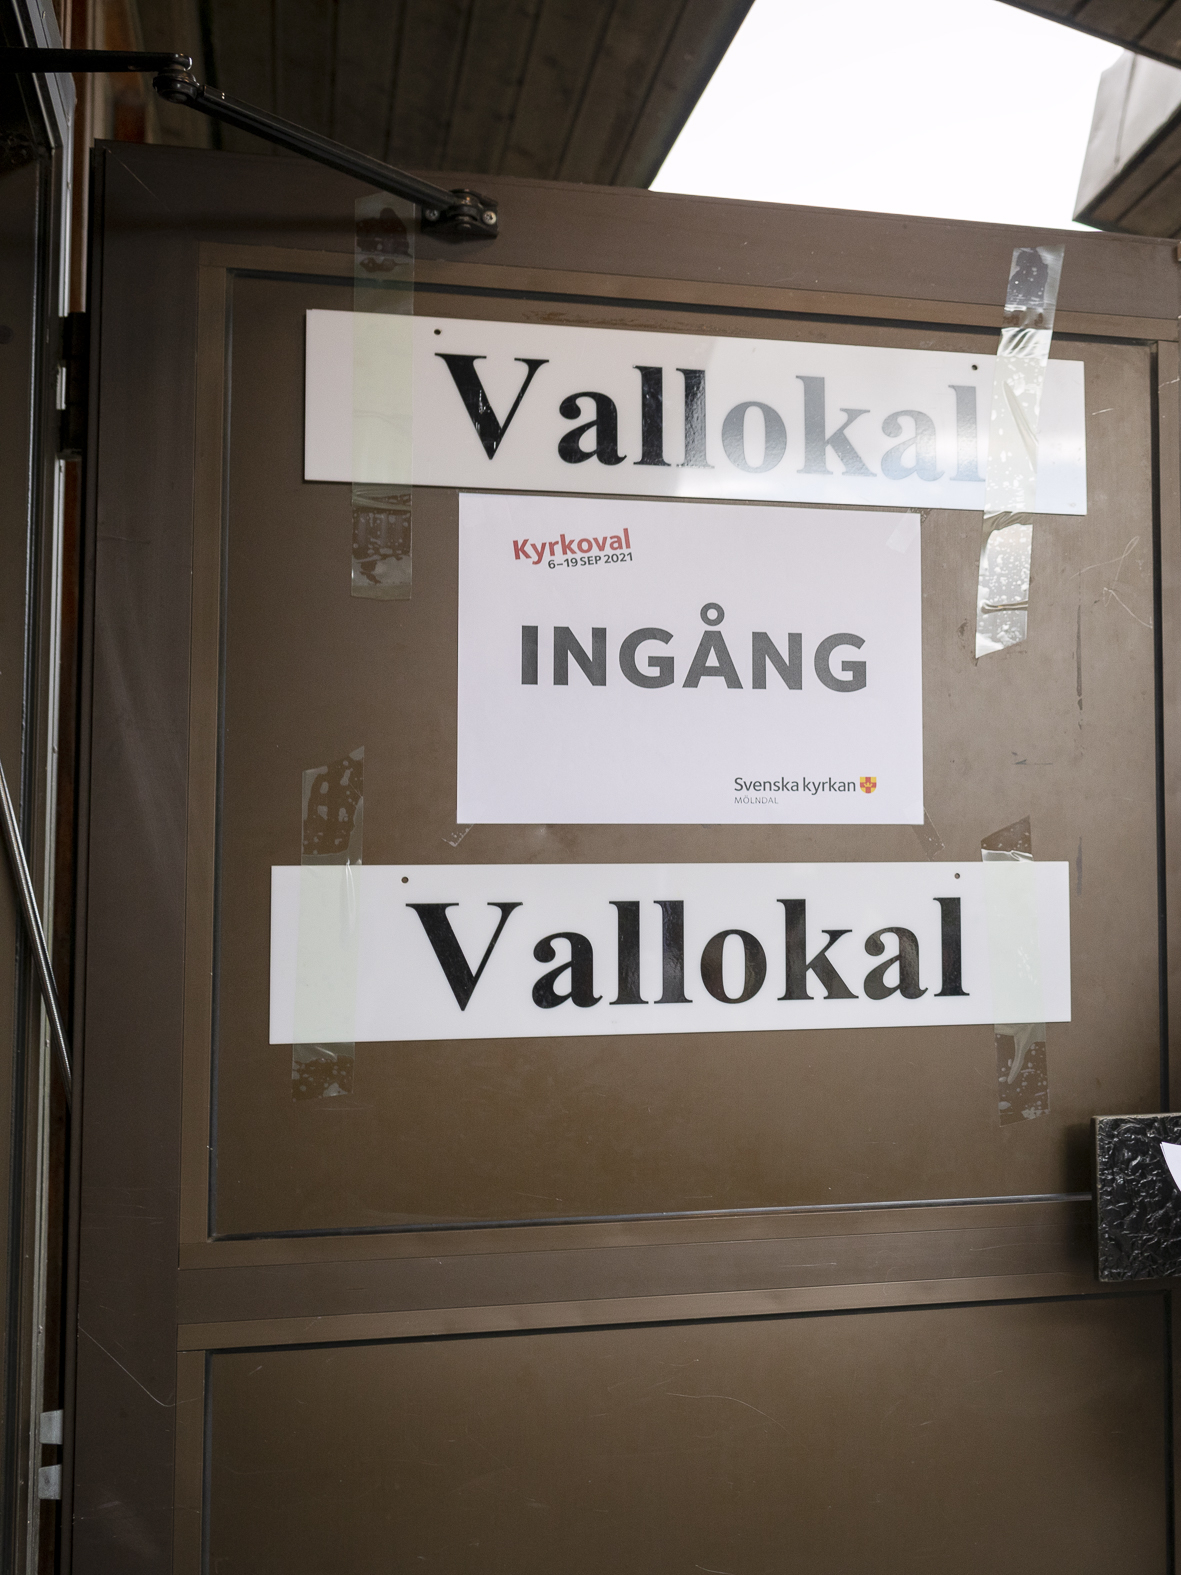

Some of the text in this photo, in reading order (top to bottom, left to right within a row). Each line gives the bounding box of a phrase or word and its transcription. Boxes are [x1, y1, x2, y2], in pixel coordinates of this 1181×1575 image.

[434, 352, 987, 483] Vallokal
[512, 527, 631, 566] Kyrkoval
[580, 555, 602, 567] SEP
[603, 552, 633, 564] 2021
[520, 602, 868, 693] INGÅNG
[734, 776, 856, 796] Svenska kyrkan
[734, 795, 779, 804] MÖLNDAL
[405, 896, 971, 1012] Vallokal
